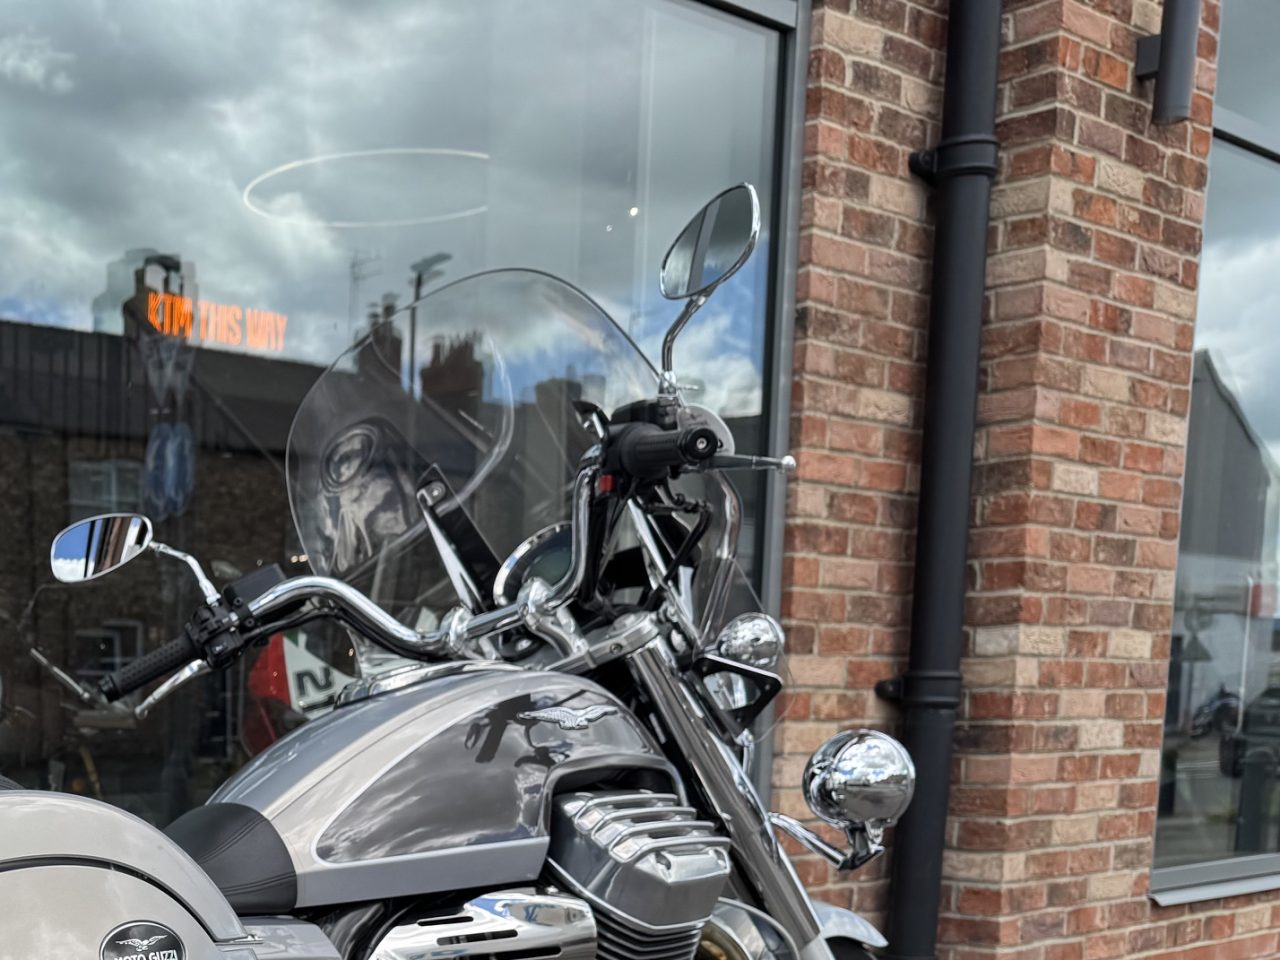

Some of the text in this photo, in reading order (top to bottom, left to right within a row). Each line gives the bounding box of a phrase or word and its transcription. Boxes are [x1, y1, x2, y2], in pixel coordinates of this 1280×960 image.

[147, 292, 288, 353] KTM THIS WAY
